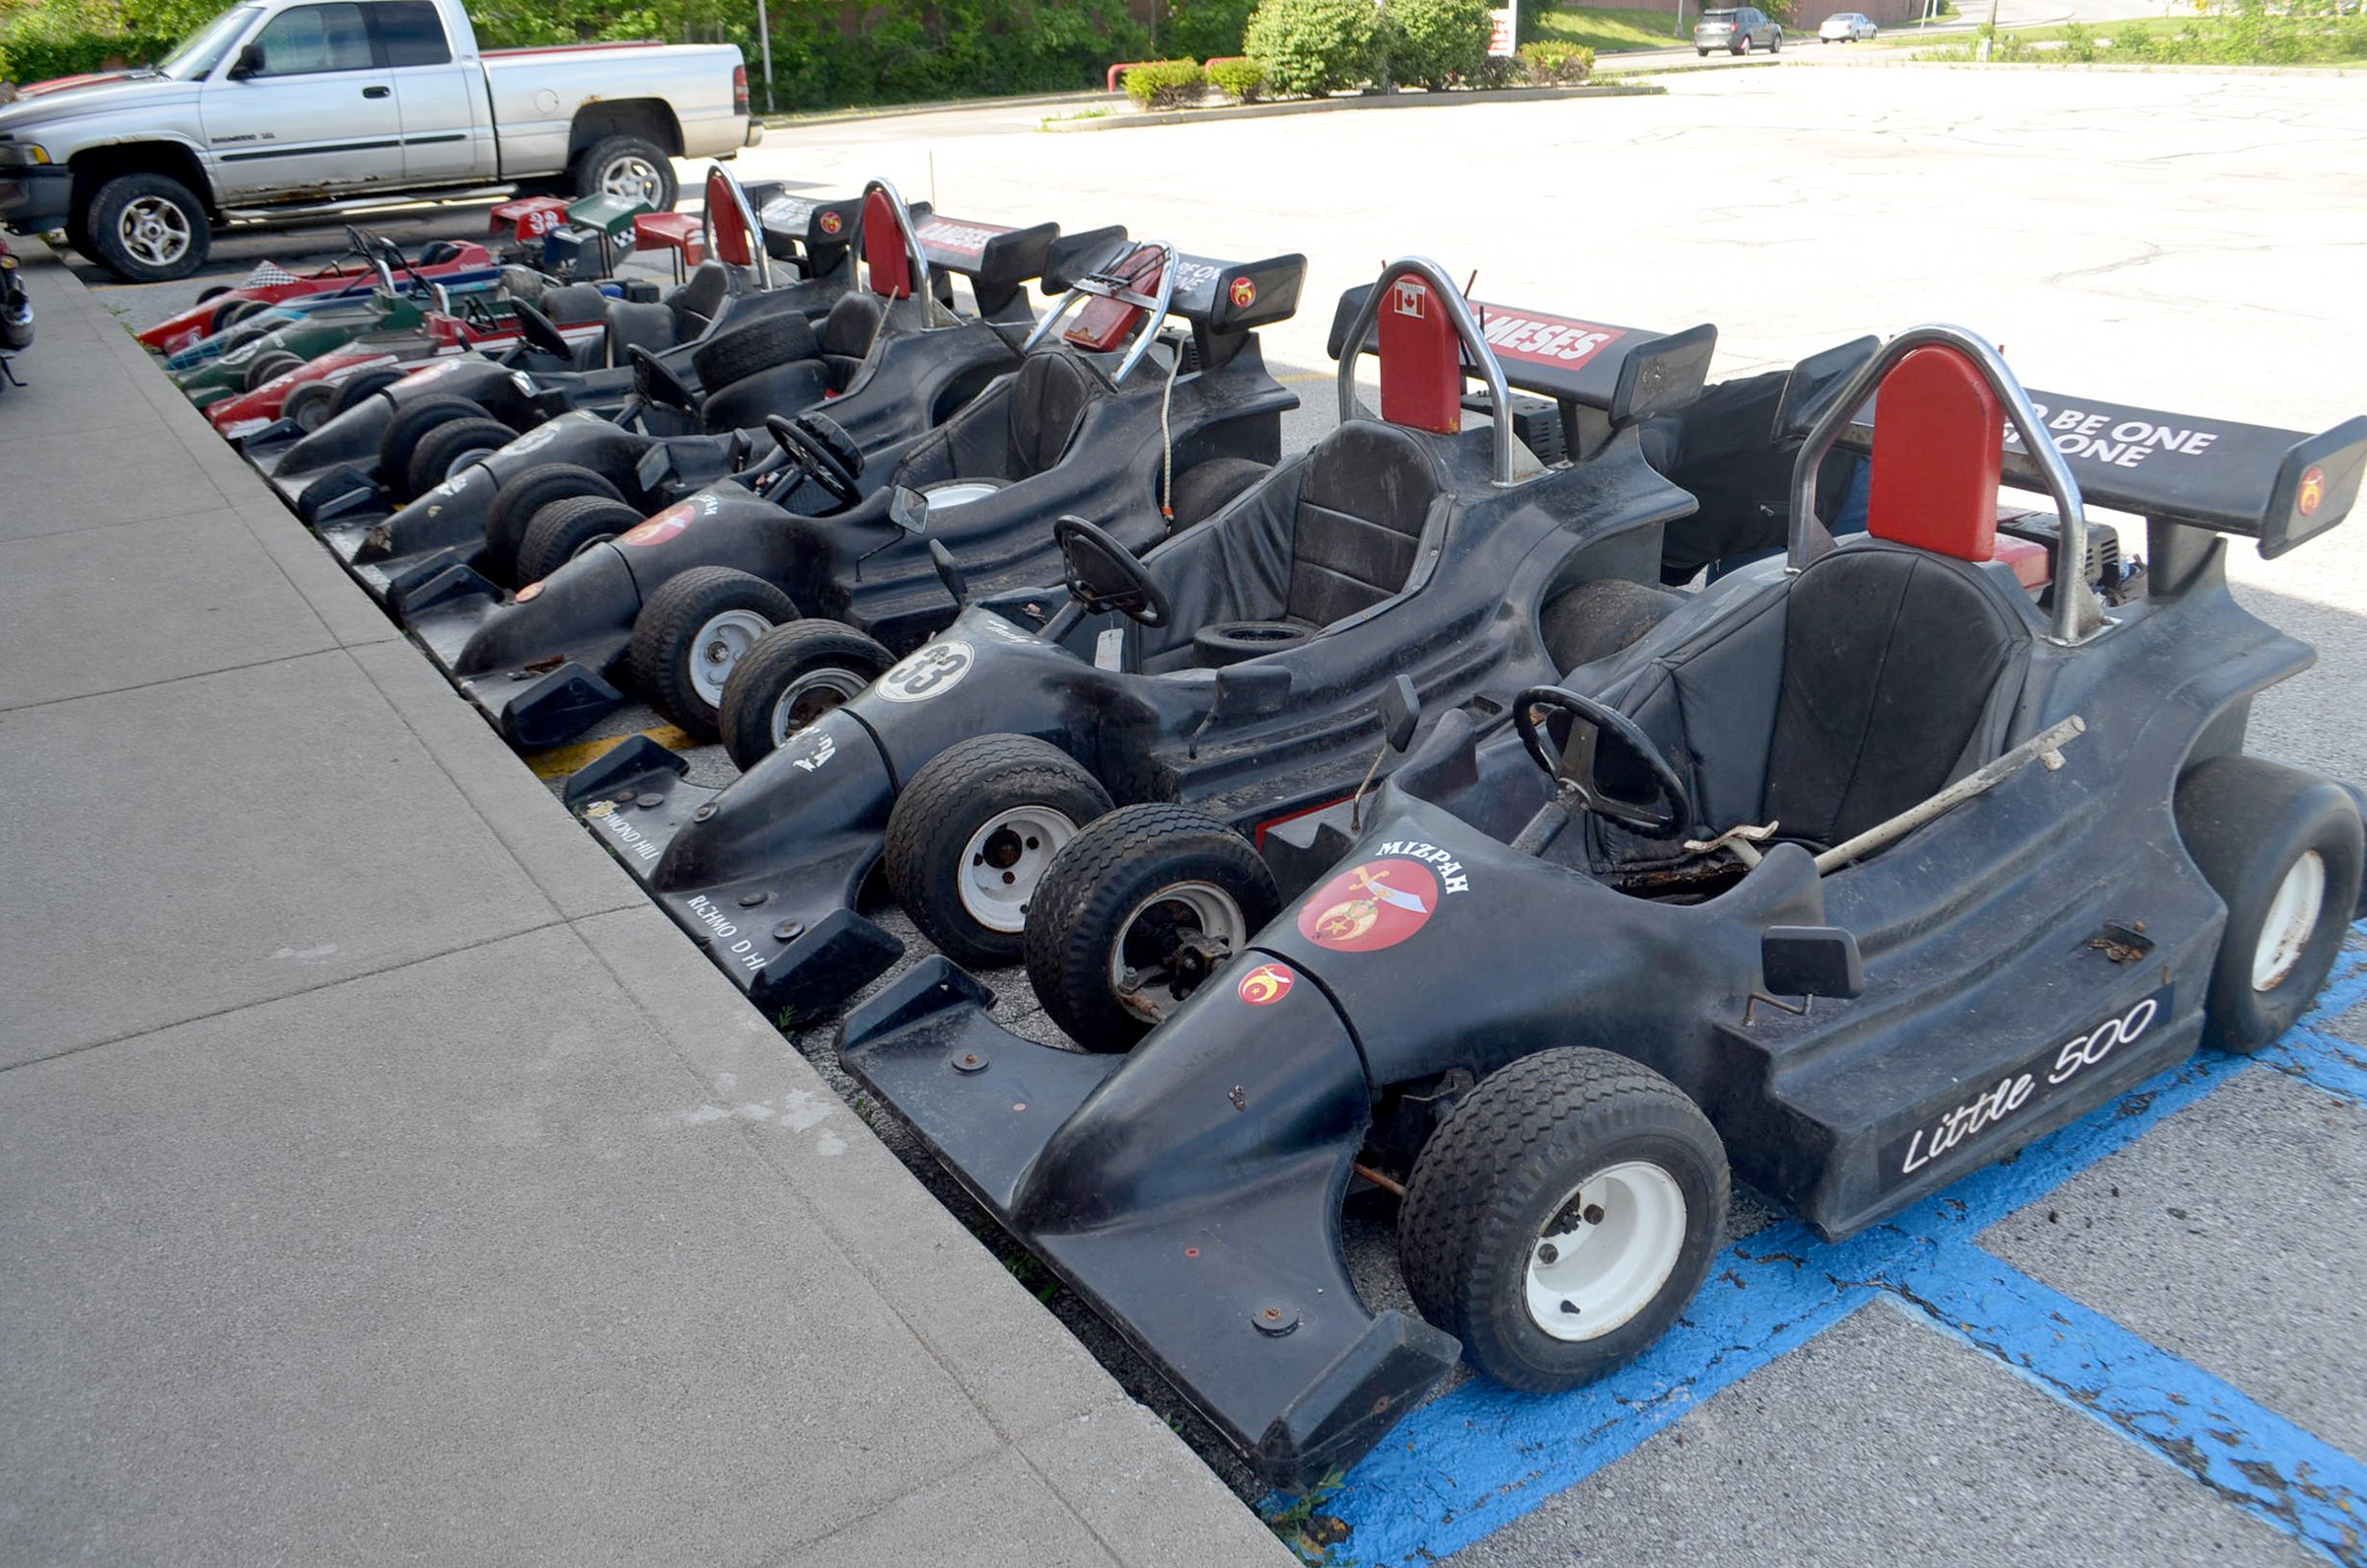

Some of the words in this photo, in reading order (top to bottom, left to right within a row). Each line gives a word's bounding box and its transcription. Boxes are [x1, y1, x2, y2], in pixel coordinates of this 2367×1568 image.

[529, 211, 560, 235] 38
[2049, 409, 2112, 435] BE
[2112, 421, 2218, 455] ONE
[2053, 434, 2154, 467] ONE
[888, 646, 968, 694] 33
[1375, 841, 1470, 895] MIZPAH
[1902, 1073, 2035, 1174] Little
[2048, 998, 2157, 1084] 500
